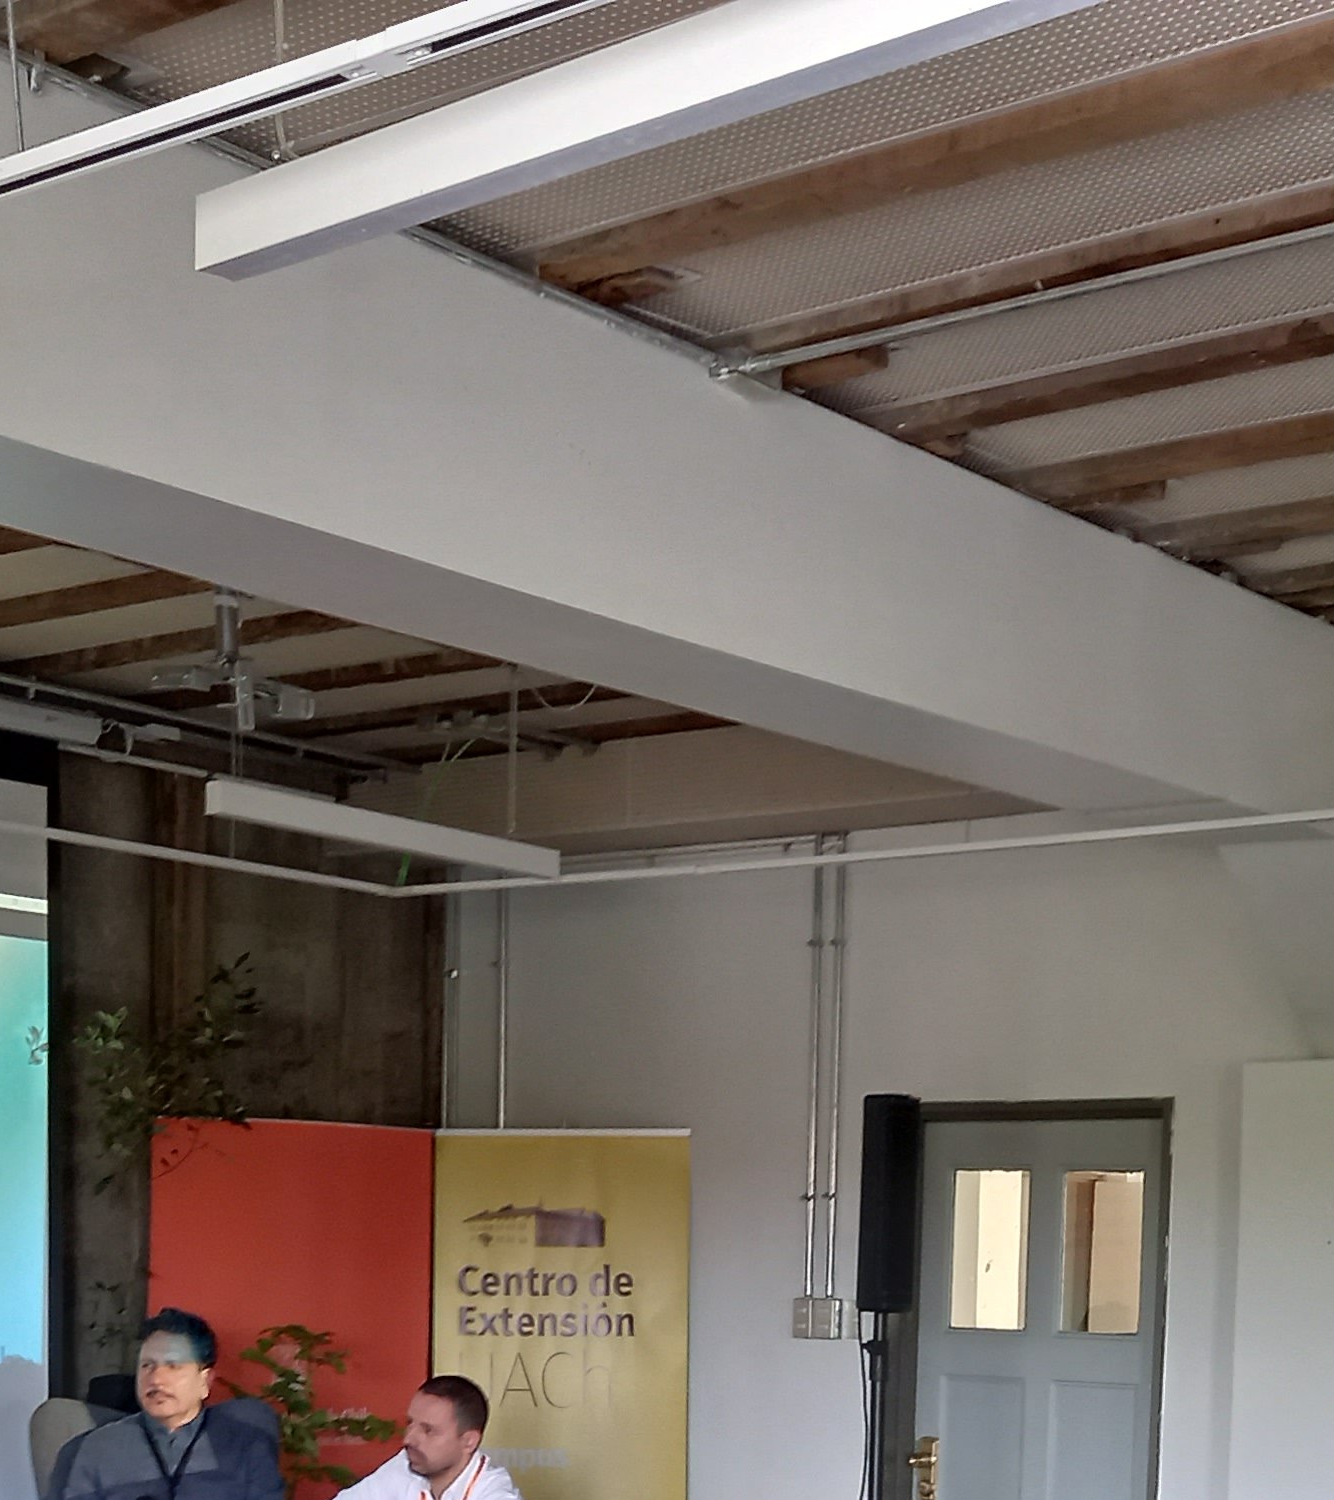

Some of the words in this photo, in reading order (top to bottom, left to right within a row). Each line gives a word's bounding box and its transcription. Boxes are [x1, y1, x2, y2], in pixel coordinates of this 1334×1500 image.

[458, 1264, 578, 1297] Centro
[589, 1264, 633, 1297] de
[458, 1302, 635, 1337] Extensión
